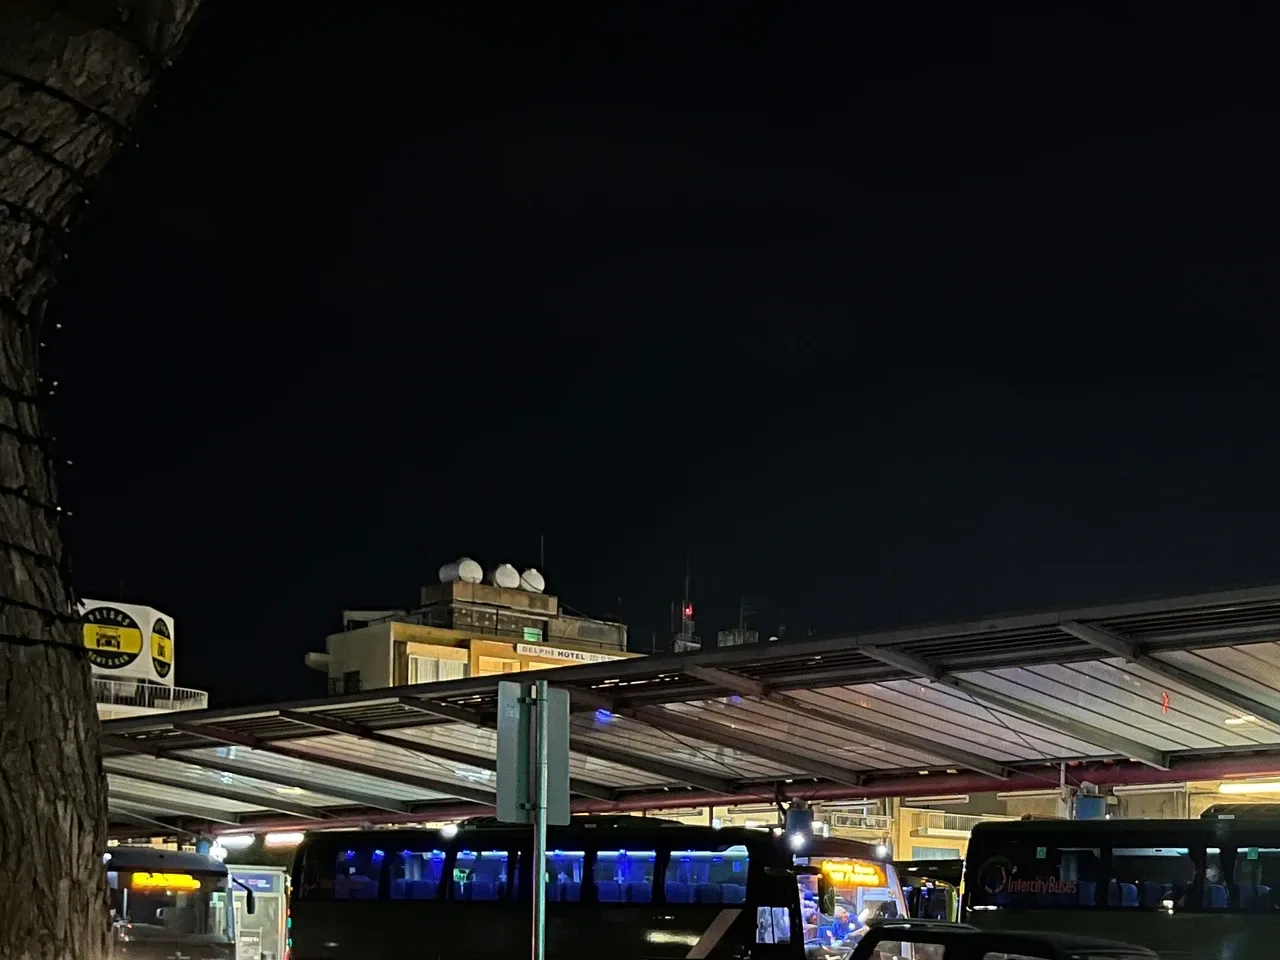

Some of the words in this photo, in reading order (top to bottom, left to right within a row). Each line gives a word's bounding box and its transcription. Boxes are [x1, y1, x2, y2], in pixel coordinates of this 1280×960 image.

[87, 609, 131, 626] PETRAS
[522, 645, 555, 657] DELPHI
[557, 650, 586, 661] HOTEL
